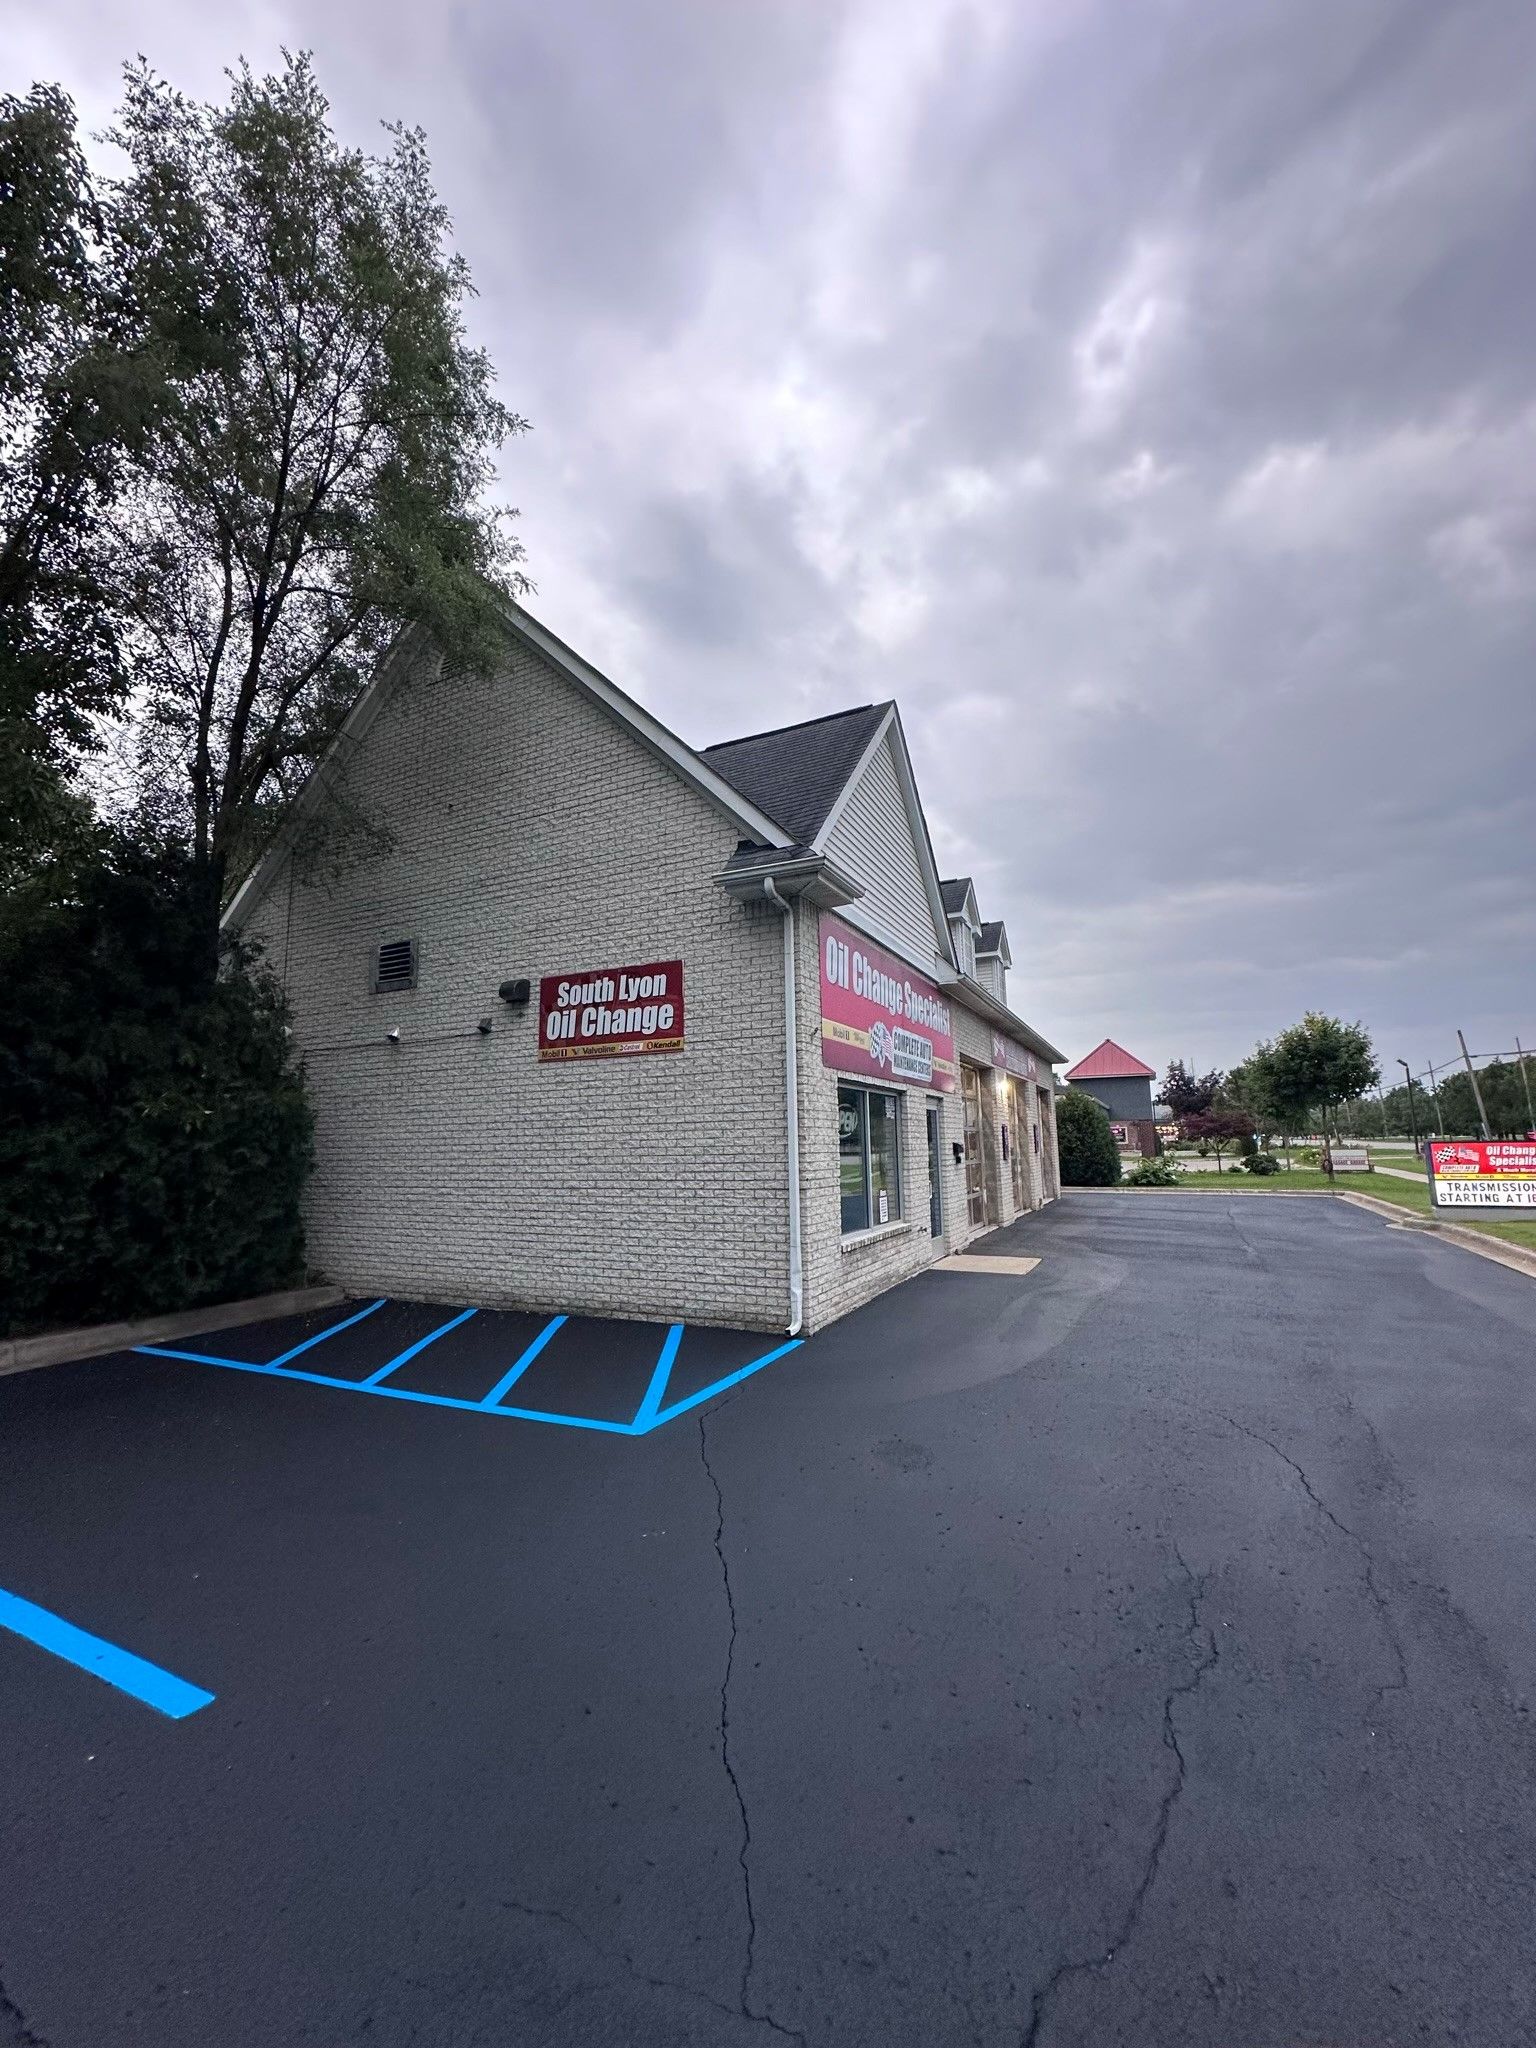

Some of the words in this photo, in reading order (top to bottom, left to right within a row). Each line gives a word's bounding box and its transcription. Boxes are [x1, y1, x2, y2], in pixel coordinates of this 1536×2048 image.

[557, 977, 615, 1007] South
[619, 973, 667, 1002] Lyon
[826, 935, 849, 990] Oil
[852, 951, 903, 1016] Change
[904, 981, 951, 1037] Specialist
[546, 1009, 577, 1040] Oil
[581, 1003, 674, 1035] Change
[582, 1045, 616, 1055] Valvoline
[653, 1039, 681, 1049] Kendall
[893, 1031, 919, 1057] COMPLETE
[838, 1109, 858, 1133] PEN
[1486, 1145, 1500, 1156] Oil
[1440, 1193, 1500, 1203] STARTING
[1506, 1193, 1522, 1203] AT
